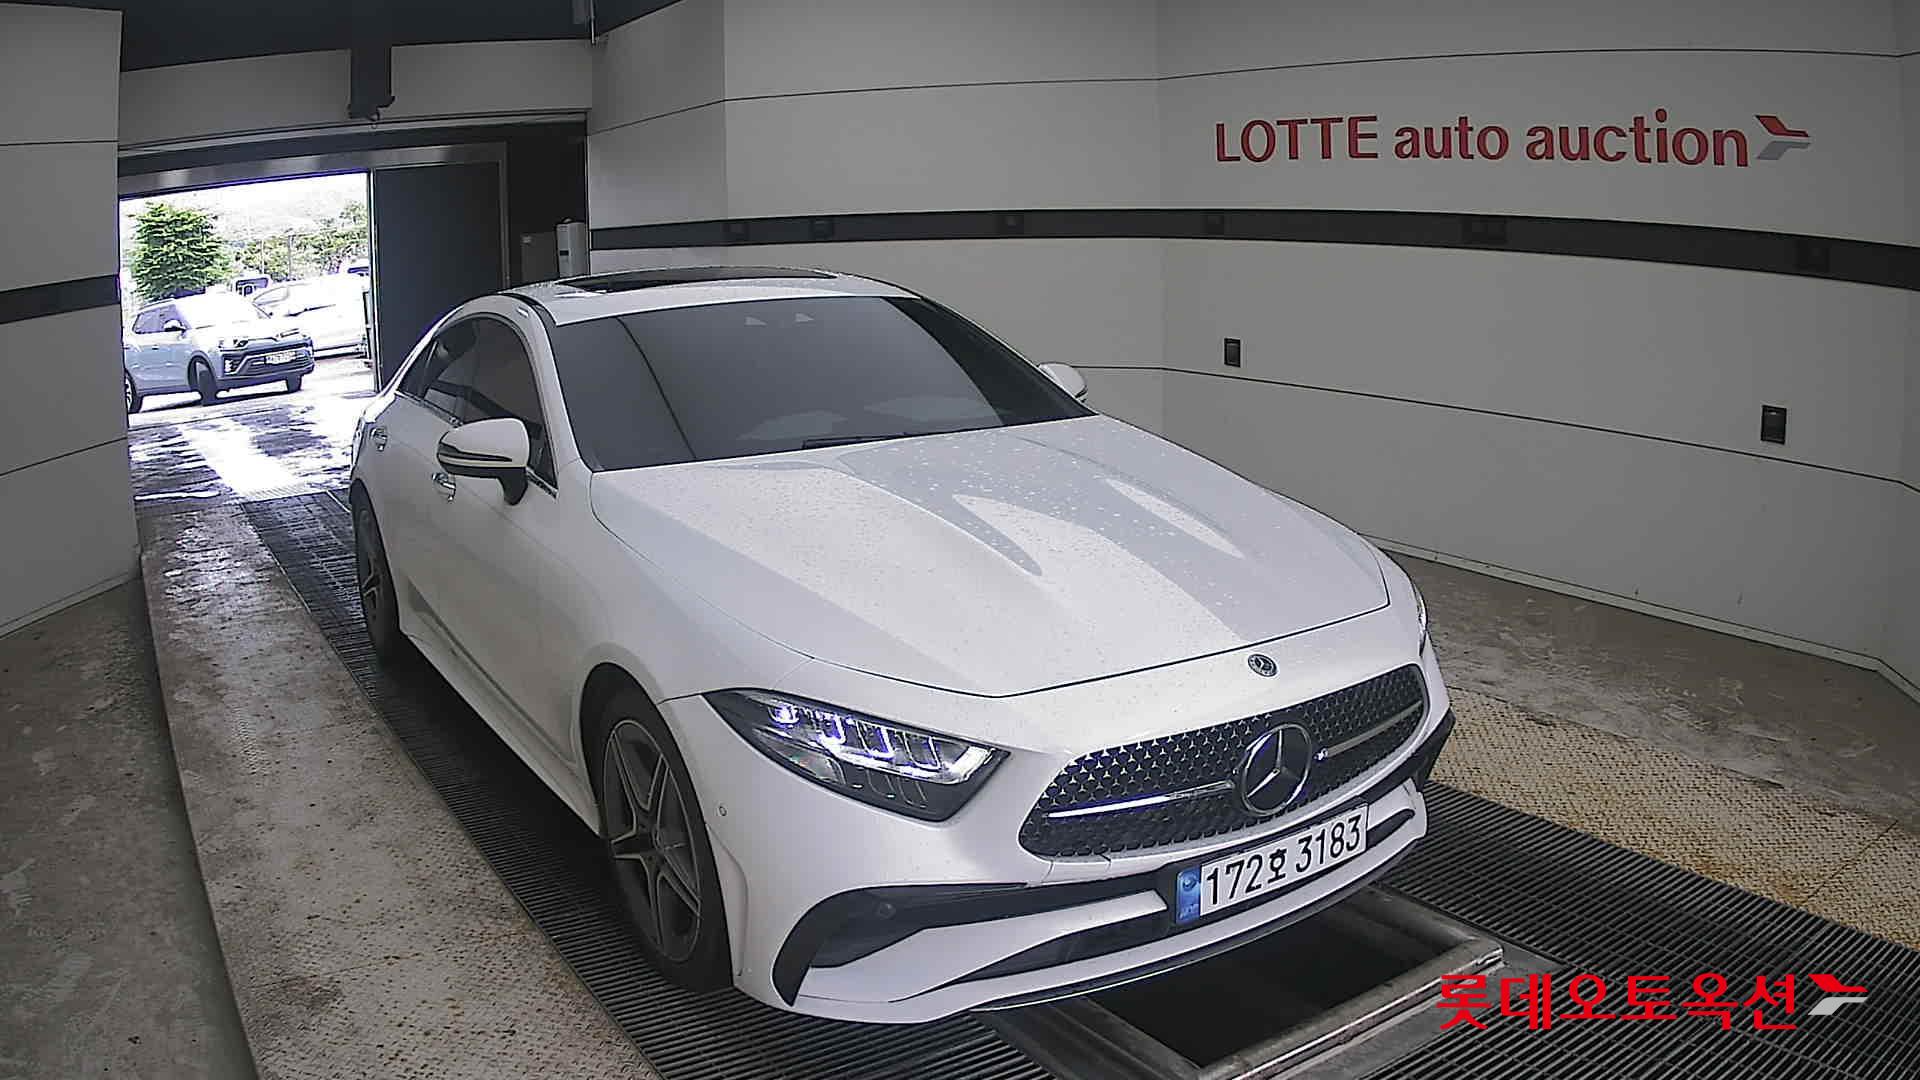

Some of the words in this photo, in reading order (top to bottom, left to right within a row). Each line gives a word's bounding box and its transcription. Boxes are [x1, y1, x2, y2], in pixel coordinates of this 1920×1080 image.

[1215, 115, 1379, 163] LOTTE
[1394, 116, 1510, 161] auto
[1526, 108, 1749, 168] auction
[1206, 848, 1288, 905] 172호
[1295, 814, 1362, 874] 3183
